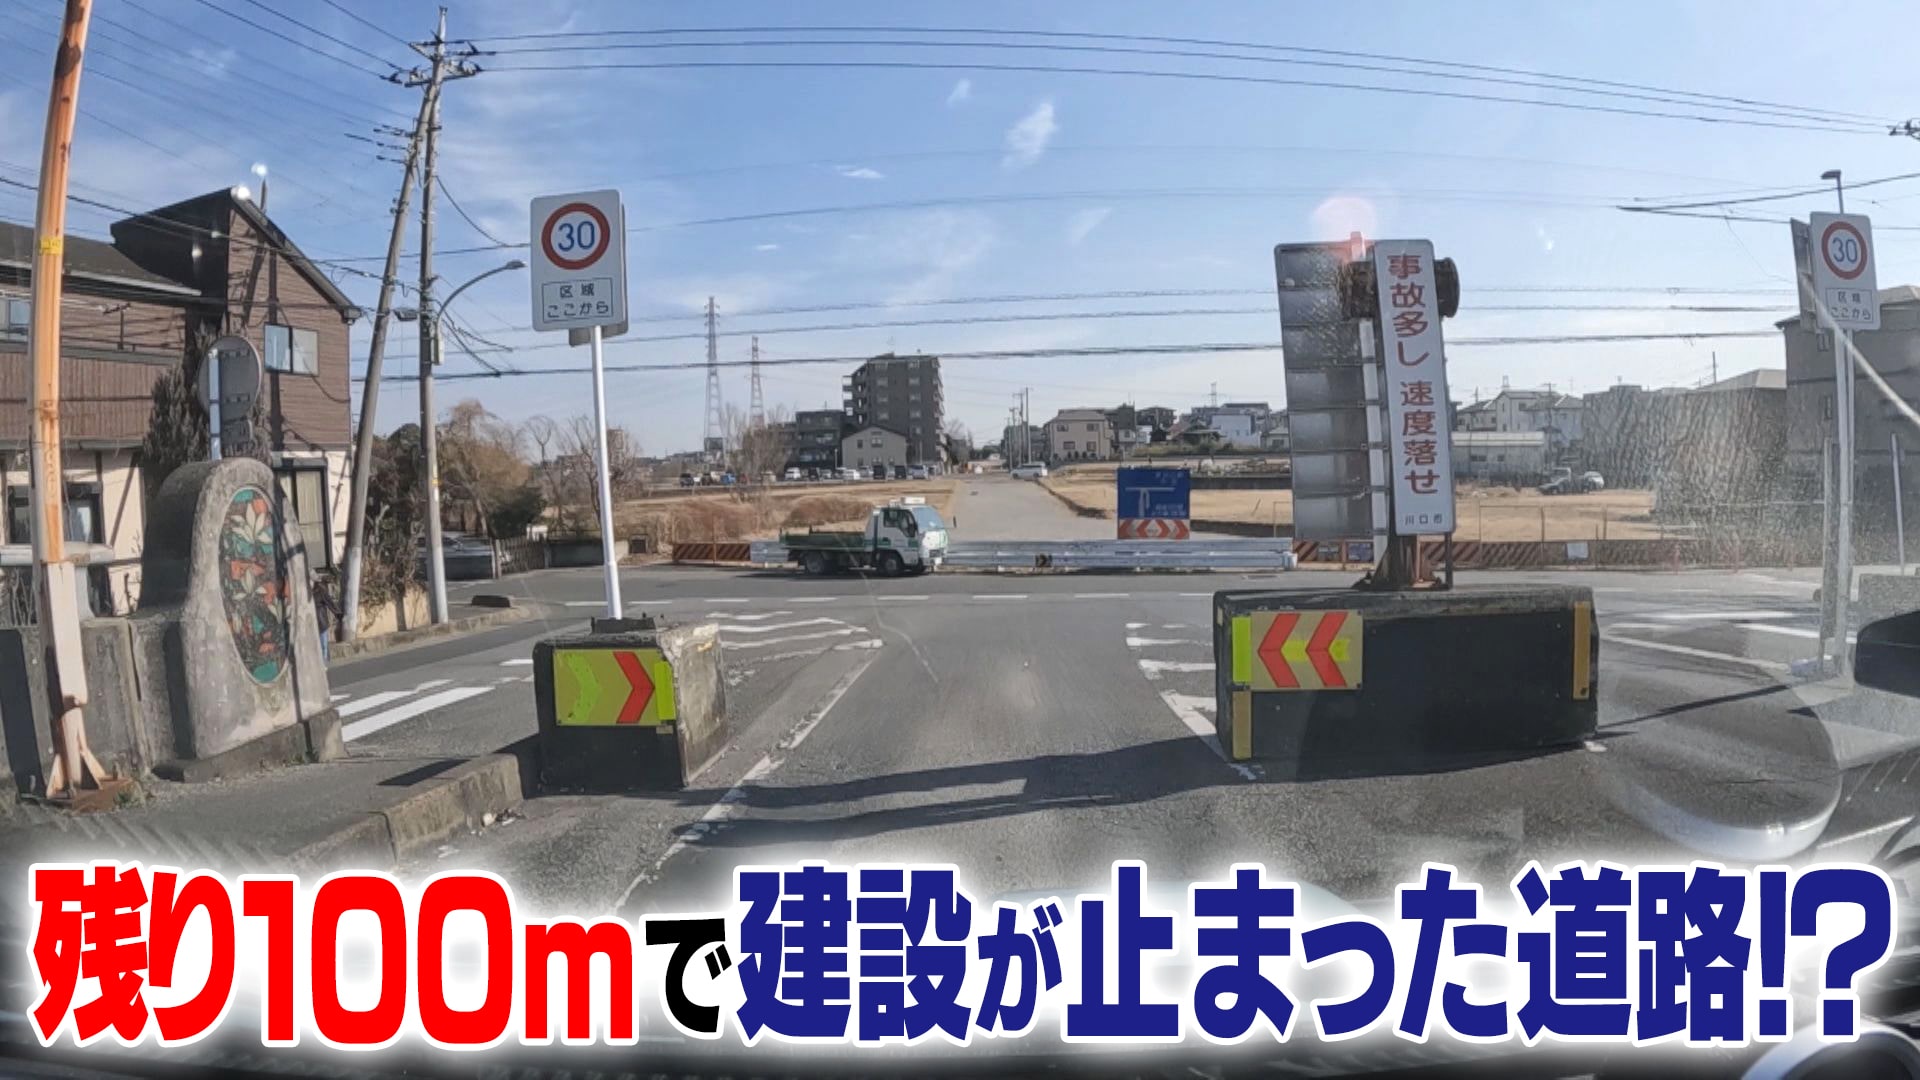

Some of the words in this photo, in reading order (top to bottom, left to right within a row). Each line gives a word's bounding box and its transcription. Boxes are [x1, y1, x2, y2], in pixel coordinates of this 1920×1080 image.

[558, 221, 595, 252] 30
[1832, 237, 1858, 263] 30
[560, 283, 595, 299] 区域
[547, 301, 609, 318] ここから
[1387, 254, 1430, 367] 事故多し
[1831, 307, 1871, 320] ここから
[1399, 380, 1440, 495] 速度落せ
[1404, 513, 1443, 525] 川口市
